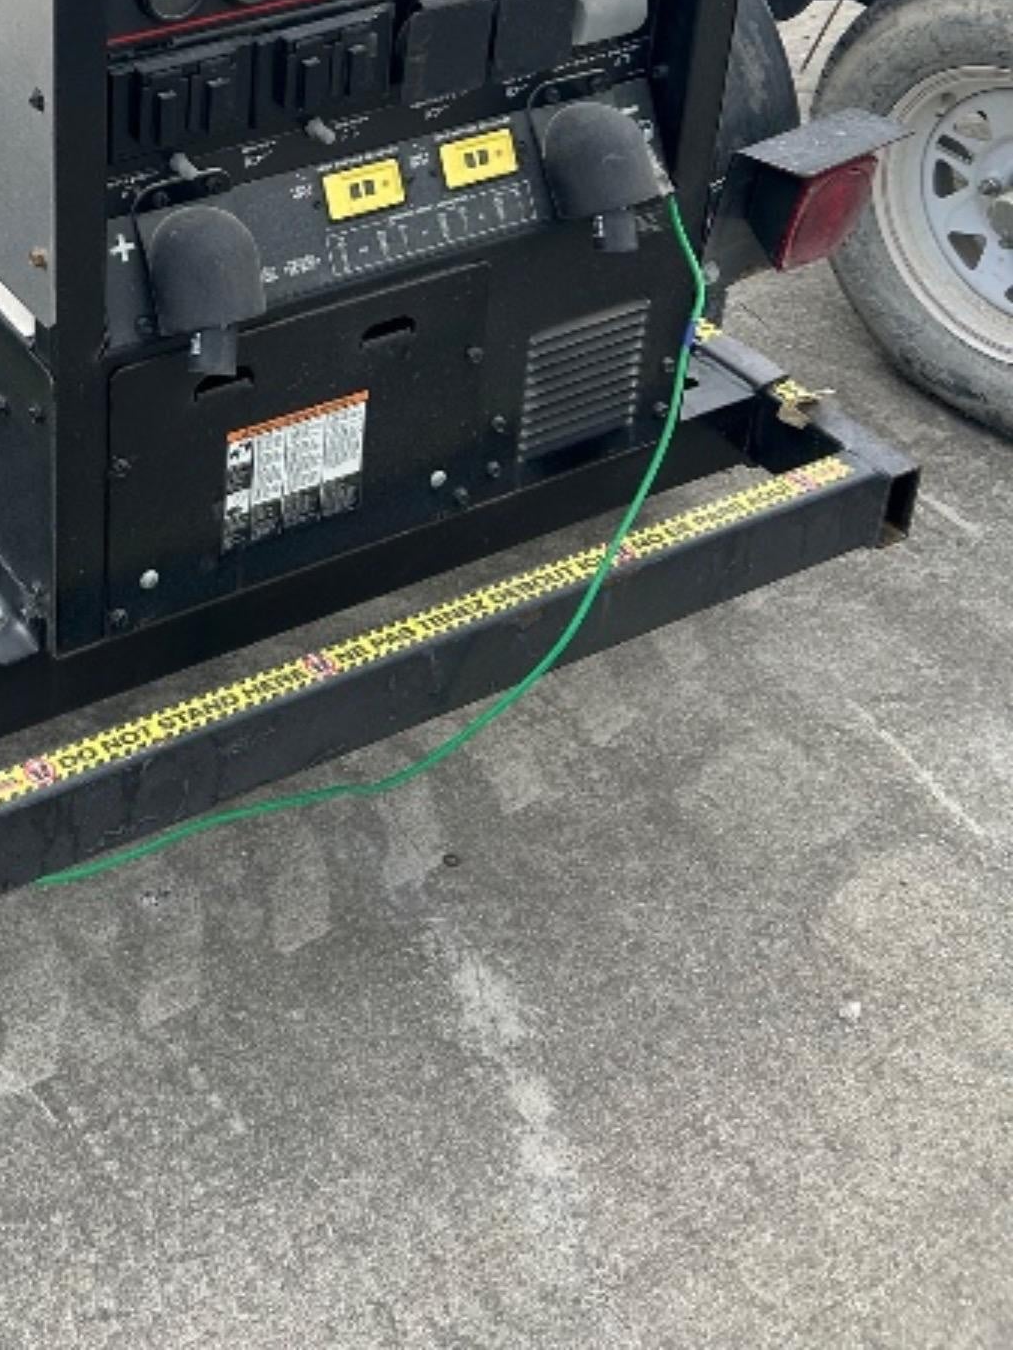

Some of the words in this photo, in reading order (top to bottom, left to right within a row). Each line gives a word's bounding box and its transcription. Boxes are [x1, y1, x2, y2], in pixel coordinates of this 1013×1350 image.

[56, 746, 97, 771] DO
[100, 727, 152, 755] NOT
[156, 693, 239, 731] STAND
[241, 668, 310, 700] HERE
